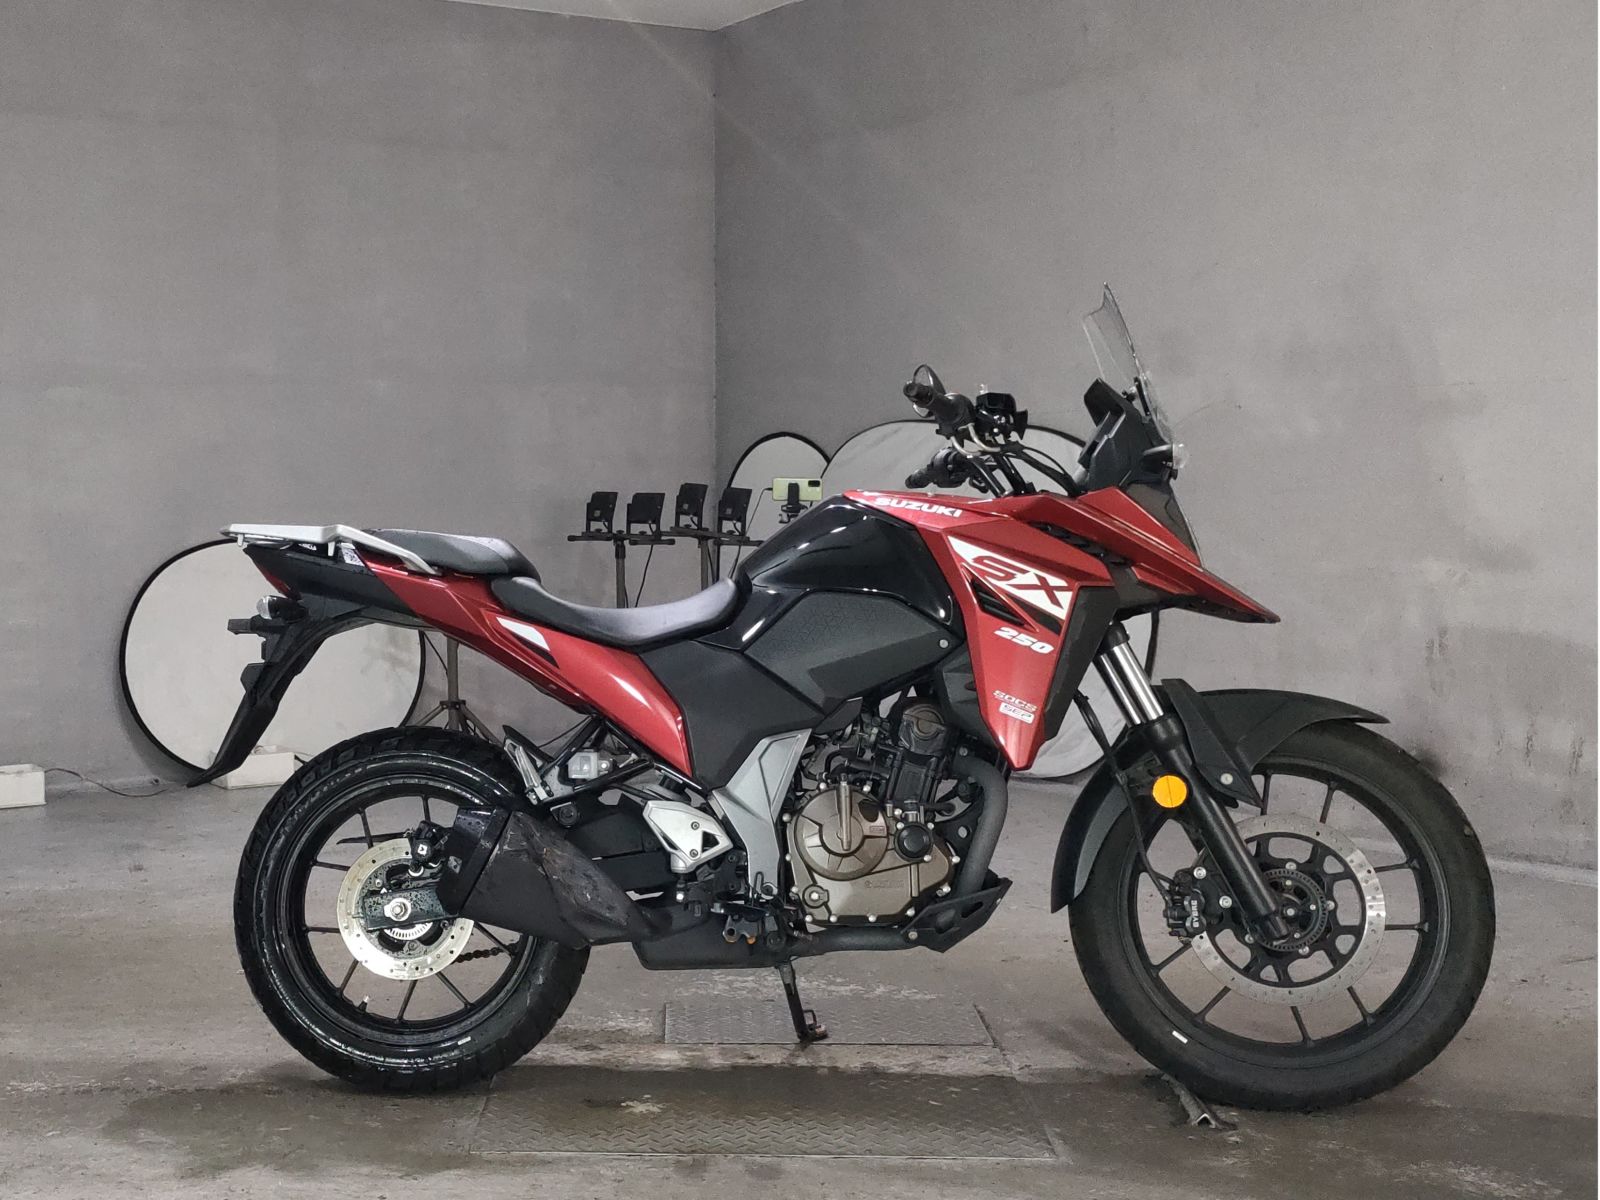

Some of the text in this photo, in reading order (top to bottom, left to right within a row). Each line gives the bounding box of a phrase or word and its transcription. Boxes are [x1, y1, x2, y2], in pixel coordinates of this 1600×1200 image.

[874, 497, 963, 518] SUZUKI
[971, 555, 1073, 610] SX
[993, 626, 1055, 654] 250
